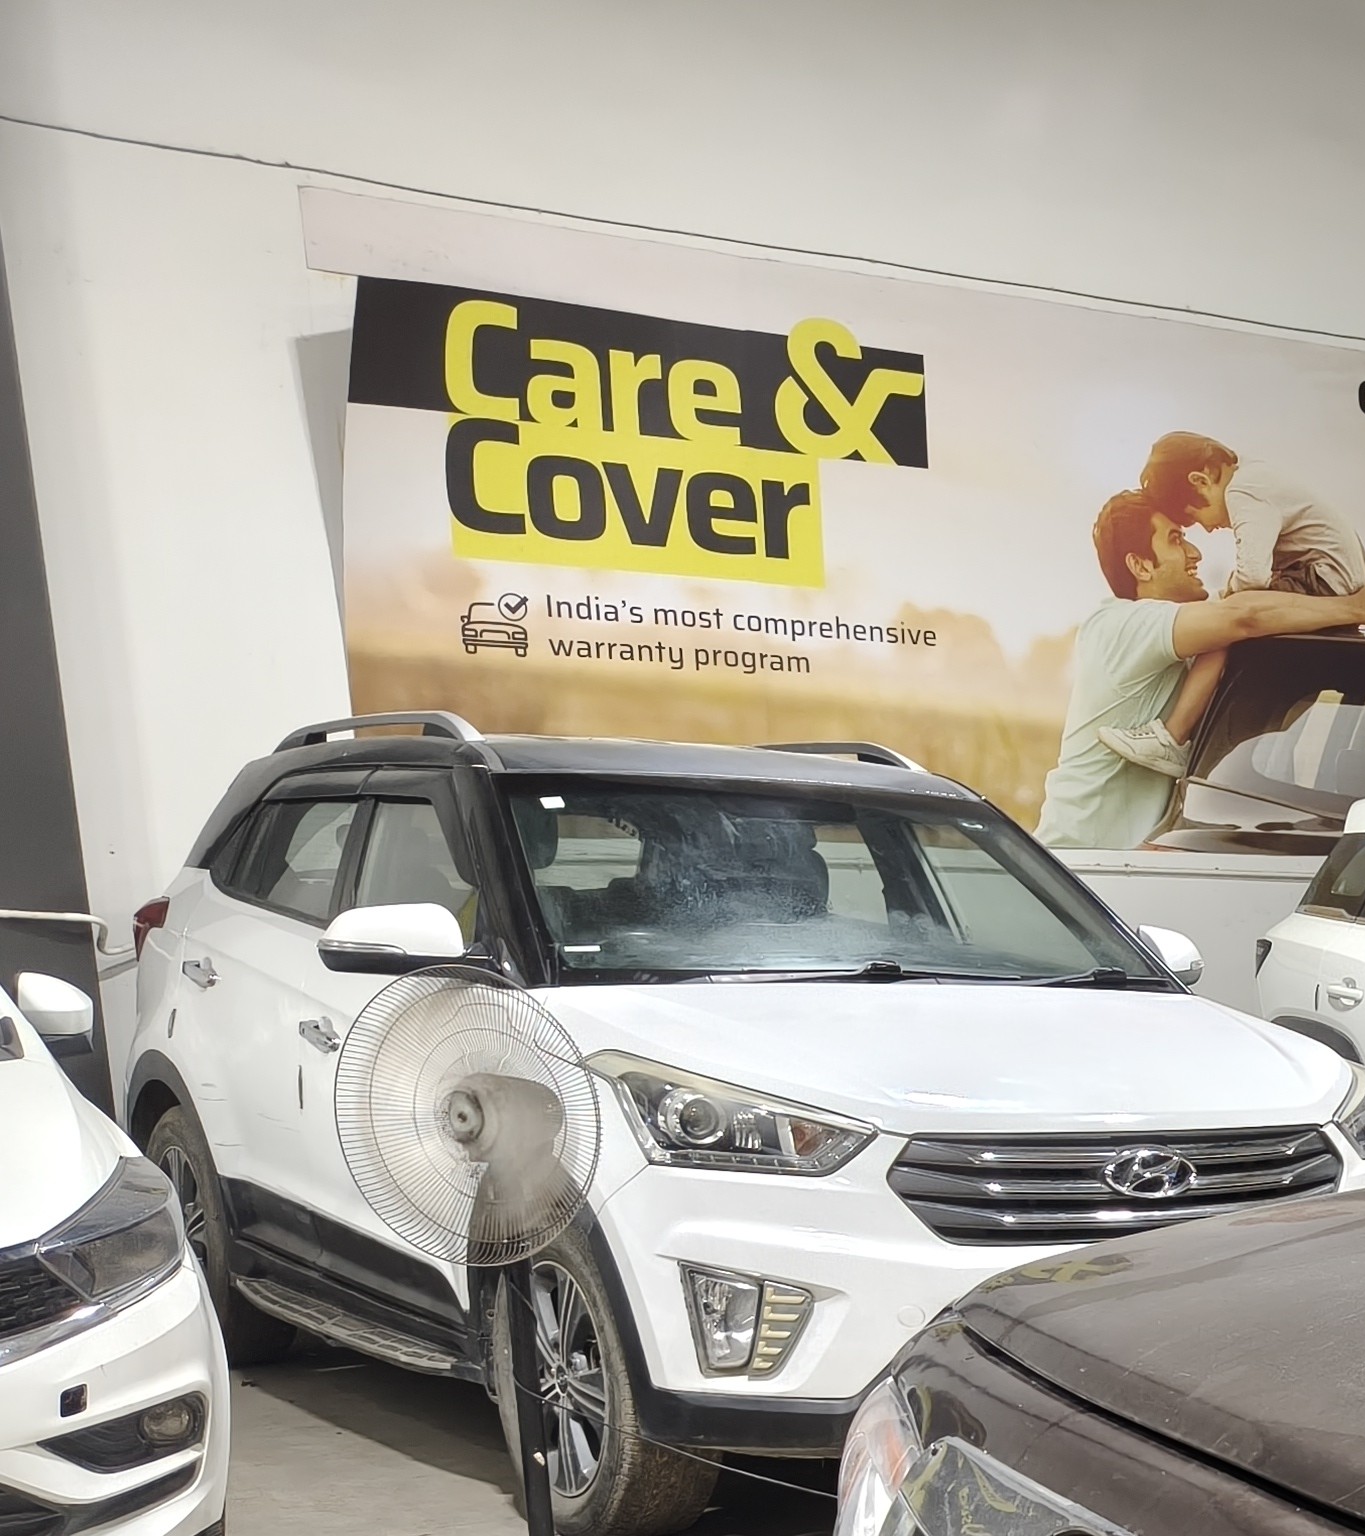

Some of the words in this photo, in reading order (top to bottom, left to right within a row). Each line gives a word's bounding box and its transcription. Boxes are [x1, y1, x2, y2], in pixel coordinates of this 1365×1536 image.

[445, 300, 742, 446] Care
[775, 317, 924, 466] &
[445, 417, 810, 560] Cover
[545, 594, 644, 626] India's
[653, 605, 724, 632] most
[732, 611, 938, 648] comprehensive
[548, 635, 685, 670] warranty
[695, 646, 811, 675] program
